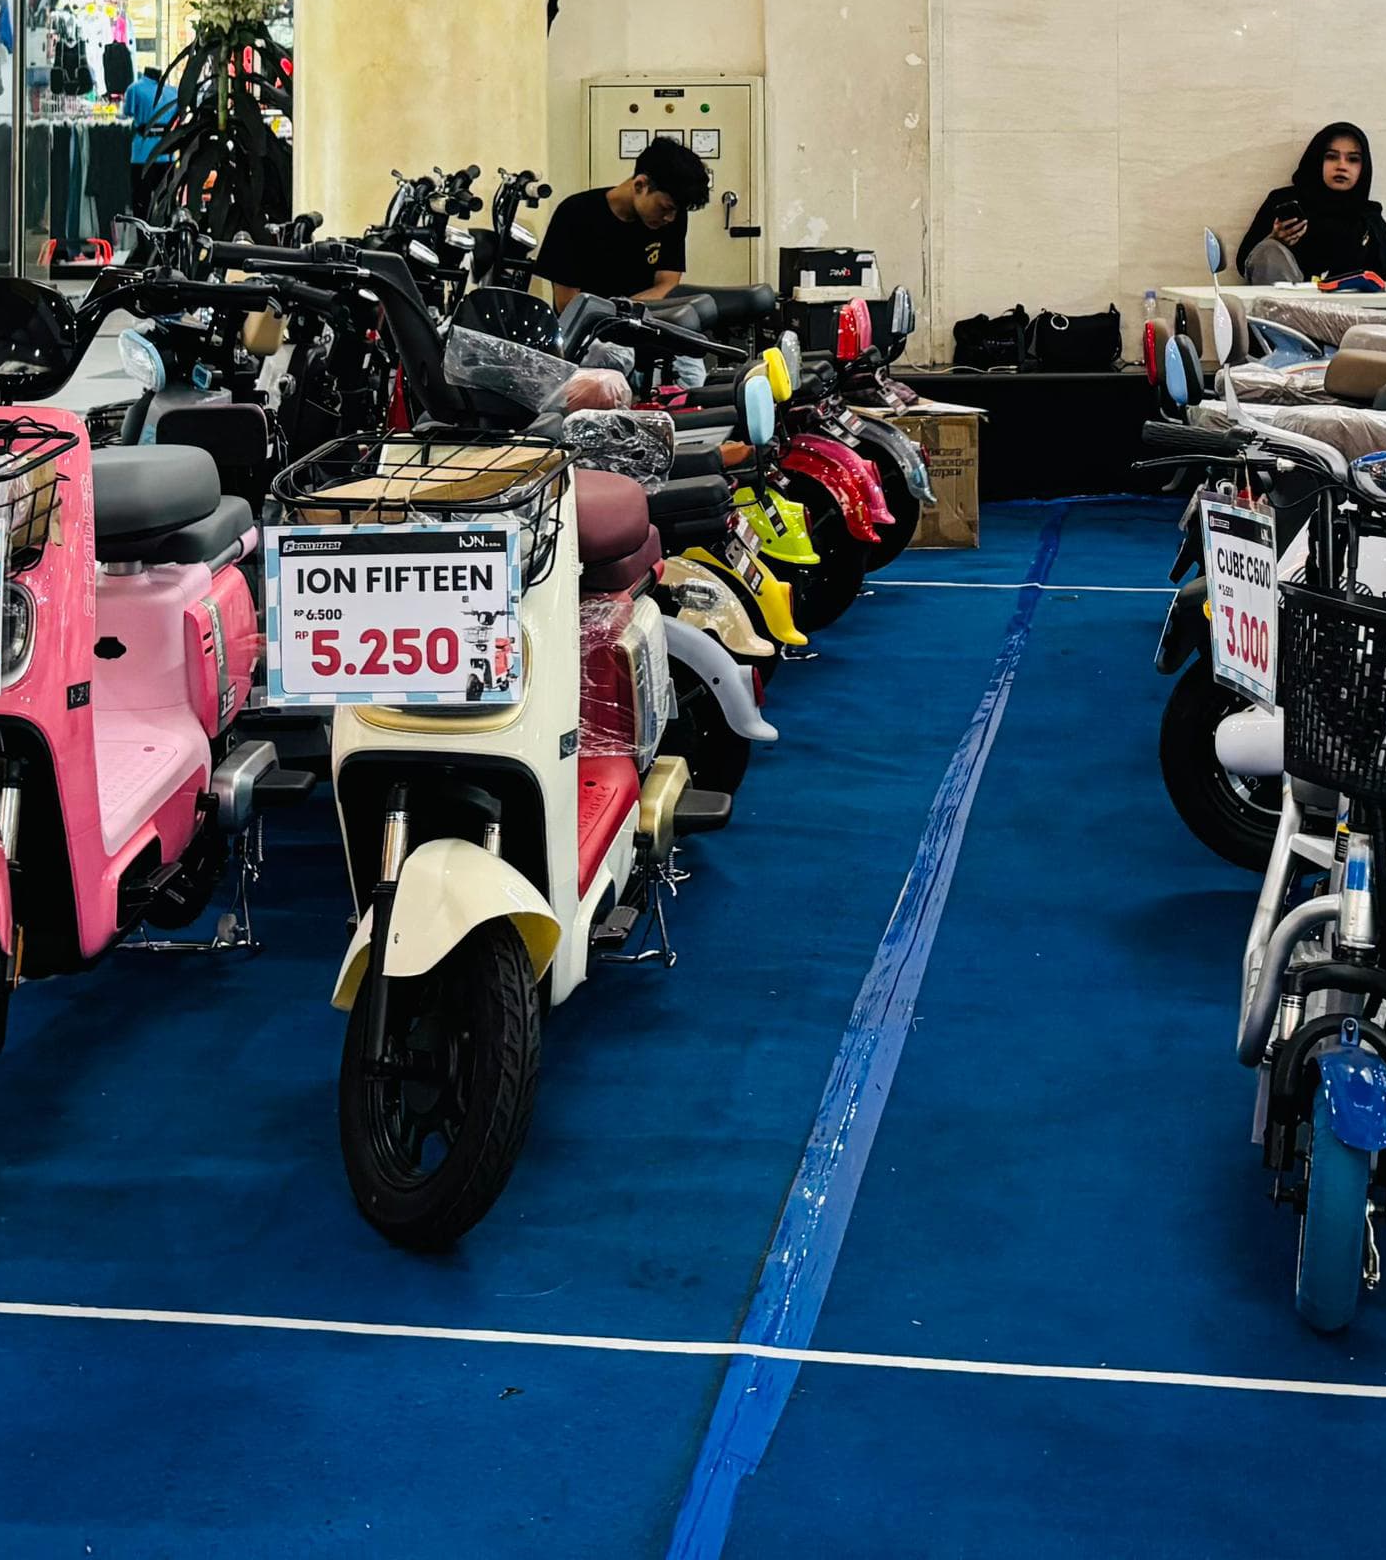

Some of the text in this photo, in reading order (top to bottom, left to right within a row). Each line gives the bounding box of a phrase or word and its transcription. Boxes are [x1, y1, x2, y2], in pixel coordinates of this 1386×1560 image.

[459, 536, 485, 549] ION
[297, 564, 493, 594] ION FIFTEEN
[1217, 547, 1271, 590] CUBE C600
[293, 608, 343, 621] RP 6.500
[295, 627, 459, 677] RP 5.250
[1225, 605, 1270, 673] 3.000
